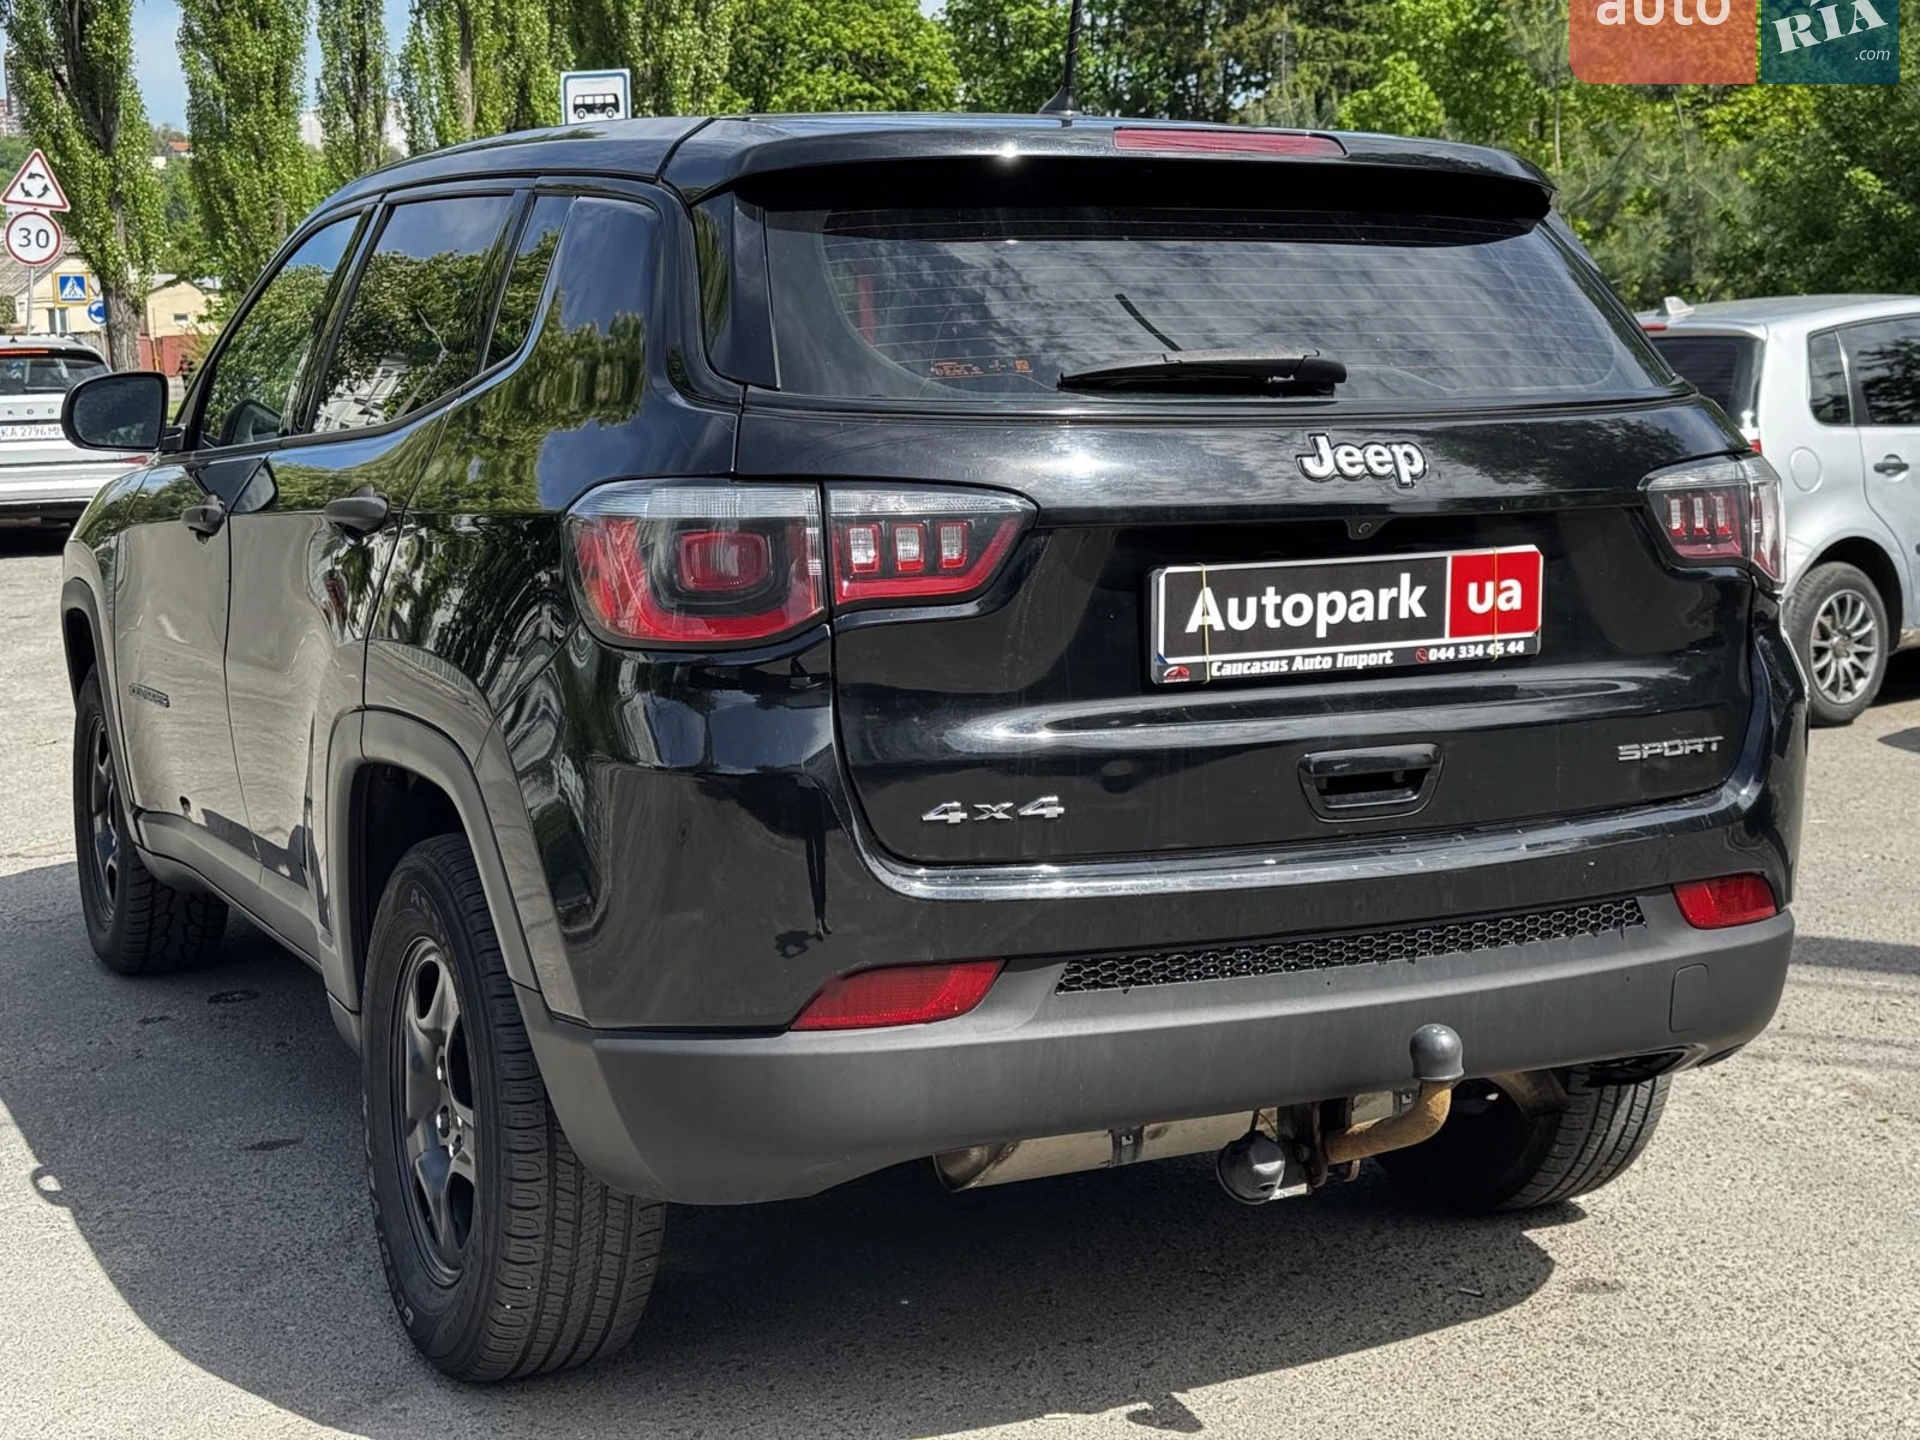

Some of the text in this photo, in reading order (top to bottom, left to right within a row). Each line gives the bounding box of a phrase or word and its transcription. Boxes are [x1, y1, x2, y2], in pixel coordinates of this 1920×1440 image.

[18, 227, 50, 249] 30
[1296, 434, 1427, 487] Jeep
[1185, 573, 1523, 638] Autopark ua
[1211, 650, 1394, 677] Caucasus Auto Import
[1428, 646, 1455, 661] 044
[1458, 643, 1484, 659] 334
[1507, 640, 1525, 654] 44
[1618, 736, 1724, 761] SPORT
